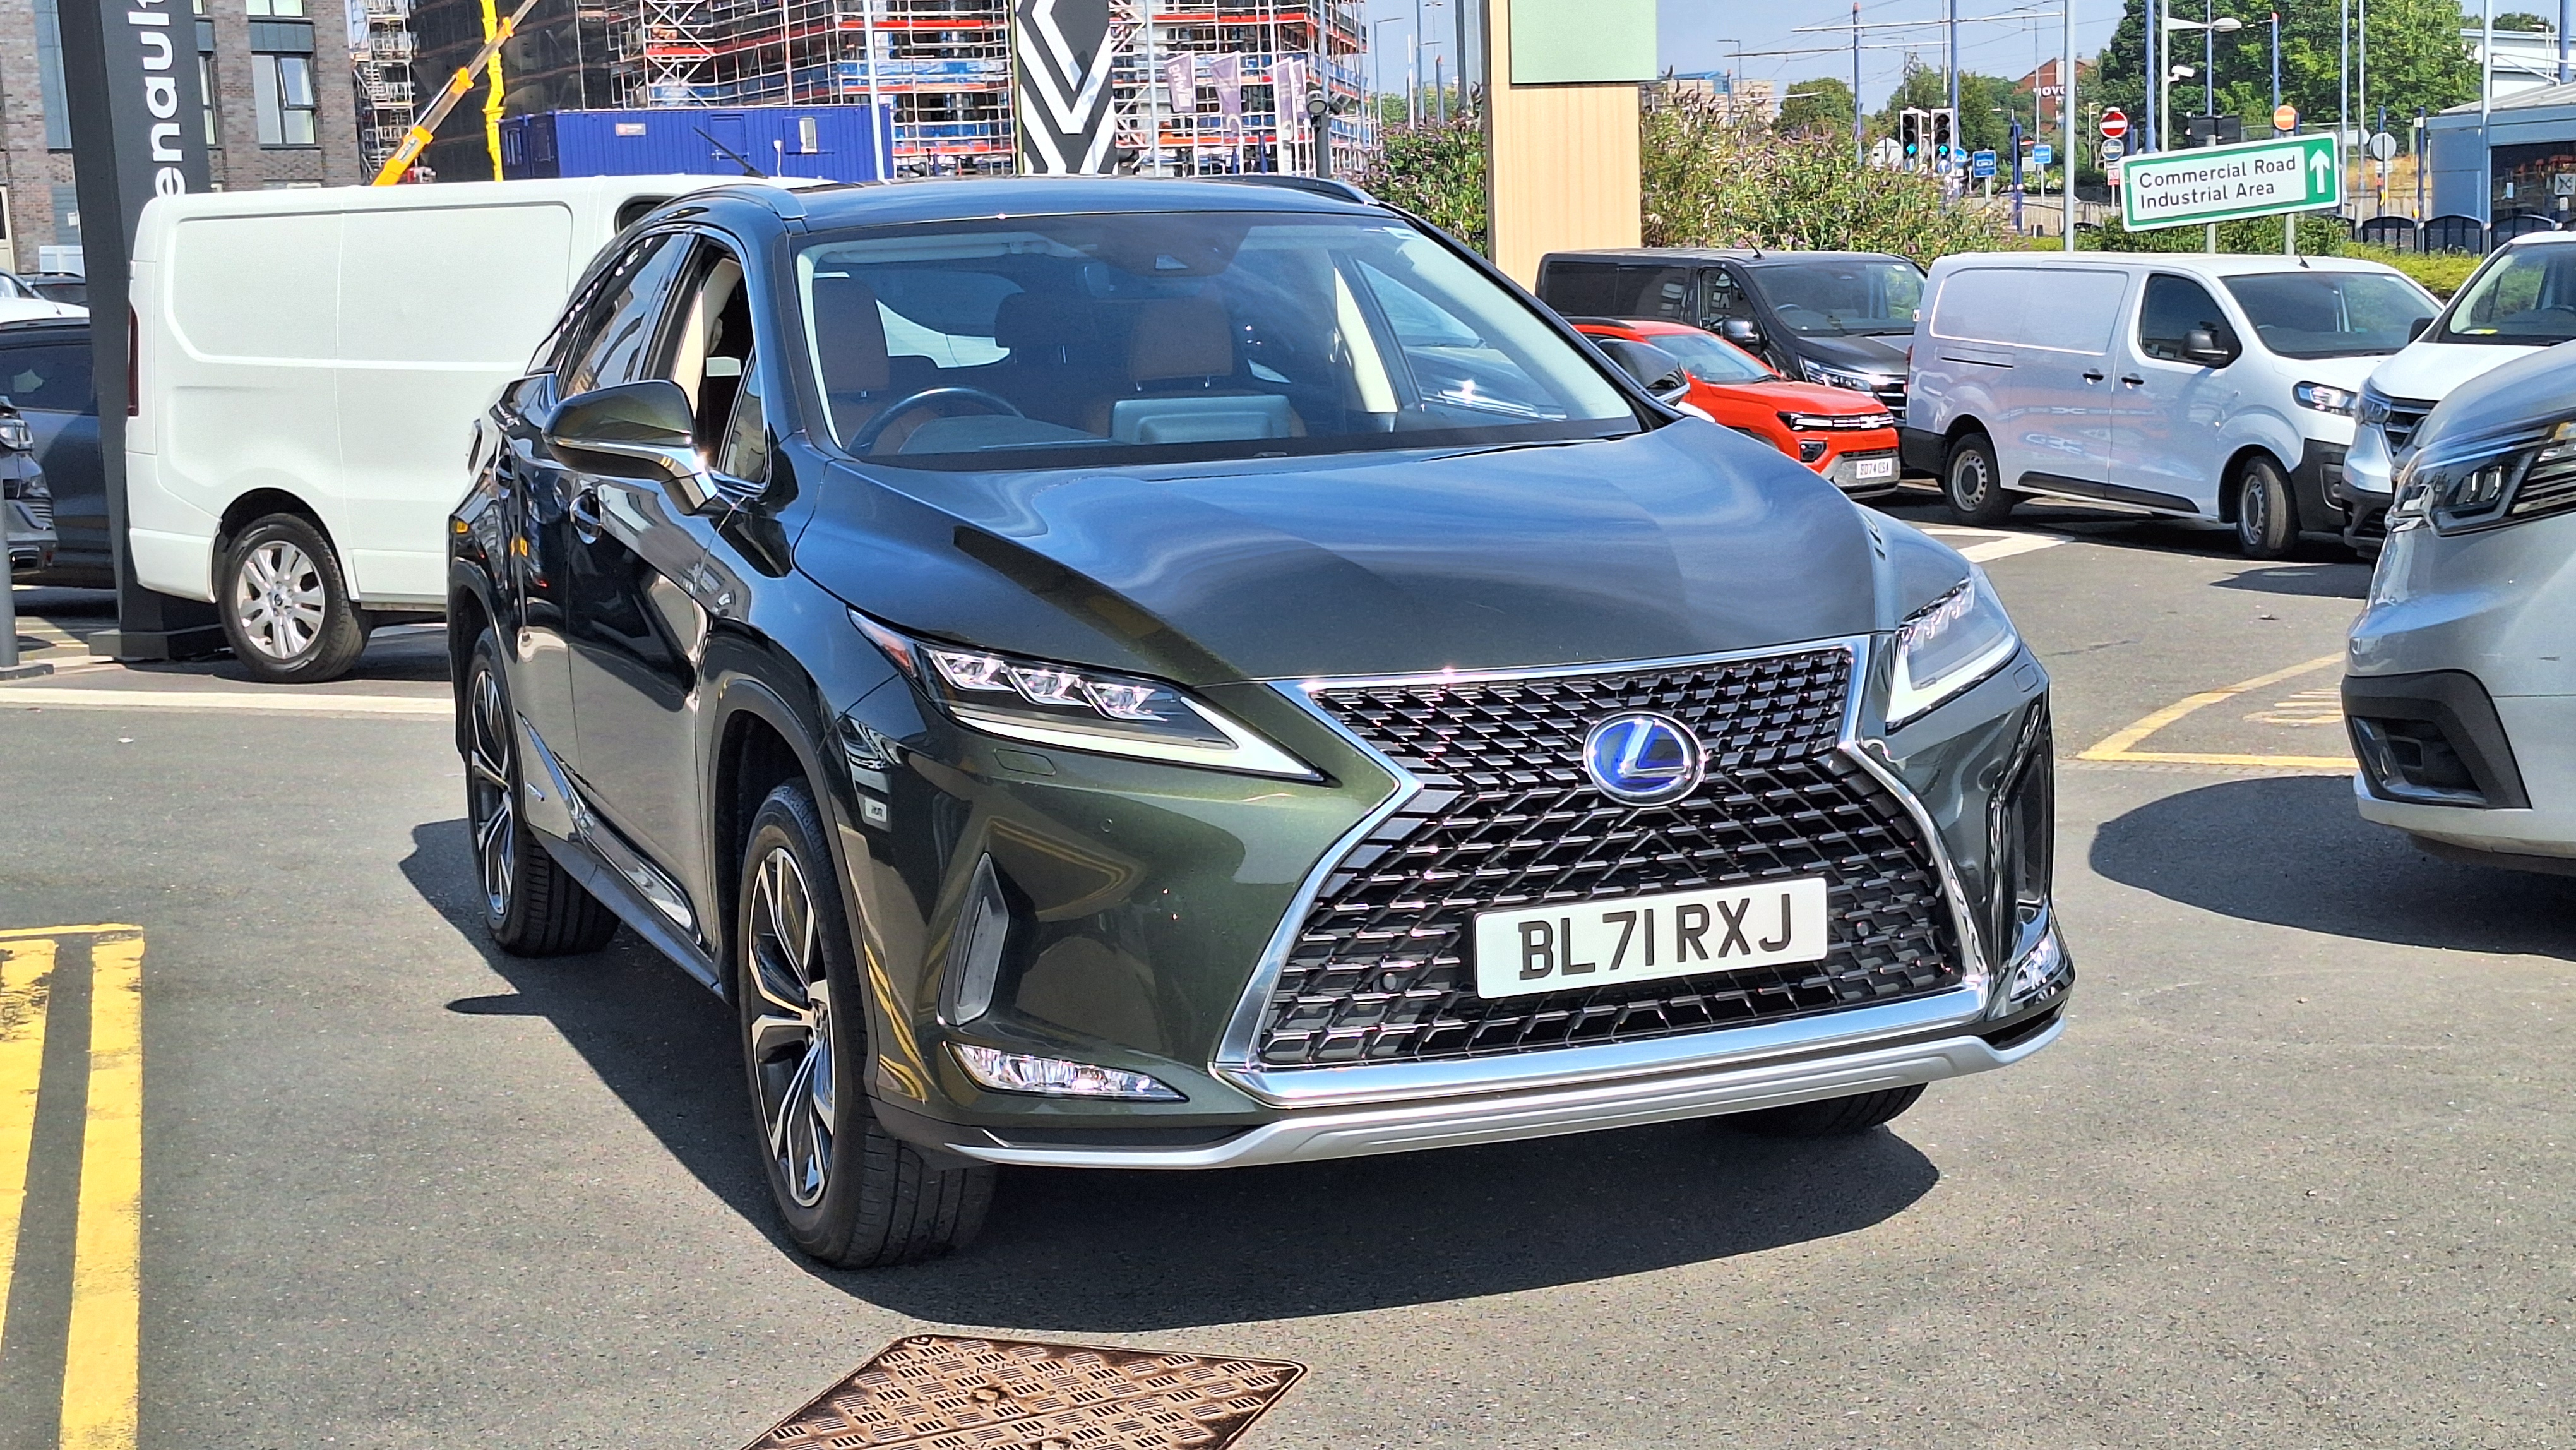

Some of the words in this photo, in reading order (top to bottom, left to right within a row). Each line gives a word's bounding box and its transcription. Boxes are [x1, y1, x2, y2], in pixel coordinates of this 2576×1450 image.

[128, 0, 186, 196] enaul
[2139, 161, 2247, 188] Commercial
[2255, 155, 2296, 175] Road
[2141, 185, 2228, 209] Industrial
[2236, 183, 2275, 198] Area
[1518, 908, 1654, 981] BL71
[1676, 894, 1791, 962] RXJ
[847, 1399, 910, 1414] EN124
[932, 1408, 962, 1418] UK
